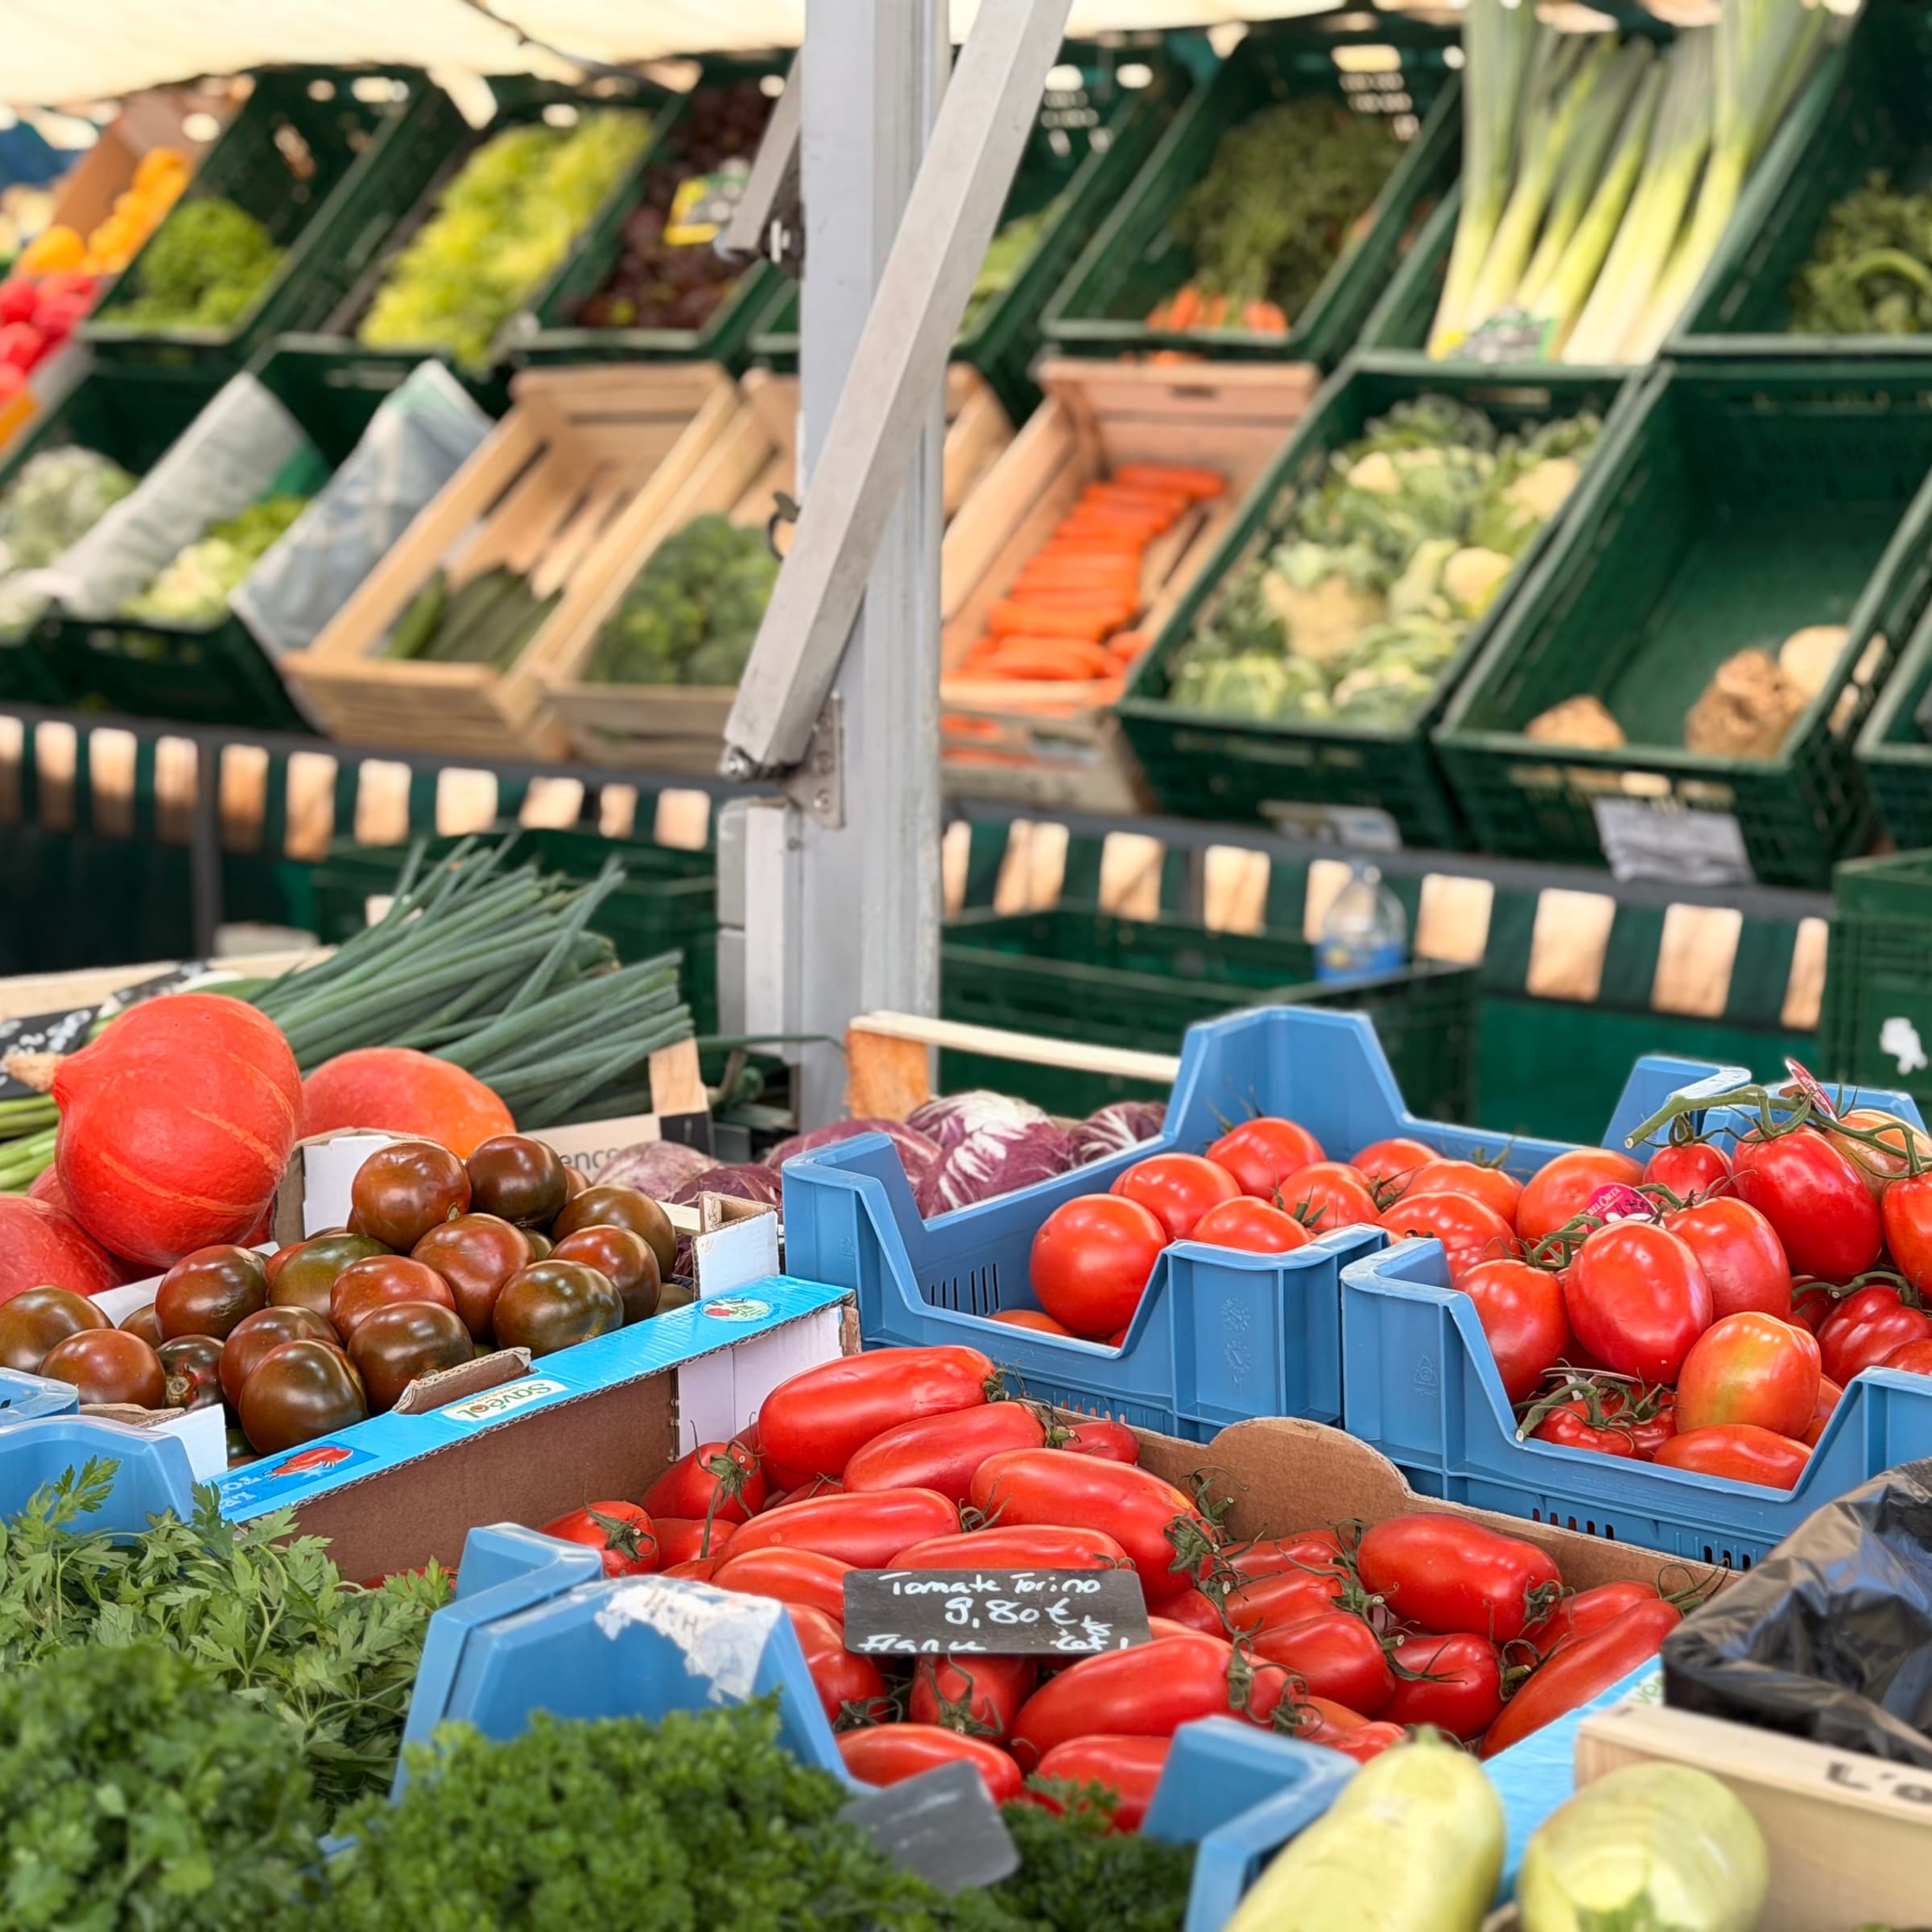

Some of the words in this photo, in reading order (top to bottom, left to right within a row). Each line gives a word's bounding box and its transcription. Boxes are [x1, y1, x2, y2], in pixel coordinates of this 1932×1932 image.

[457, 1383, 552, 1418] Savéol
[877, 1571, 1001, 1596] Tomate
[1009, 1572, 1101, 1594] Torino
